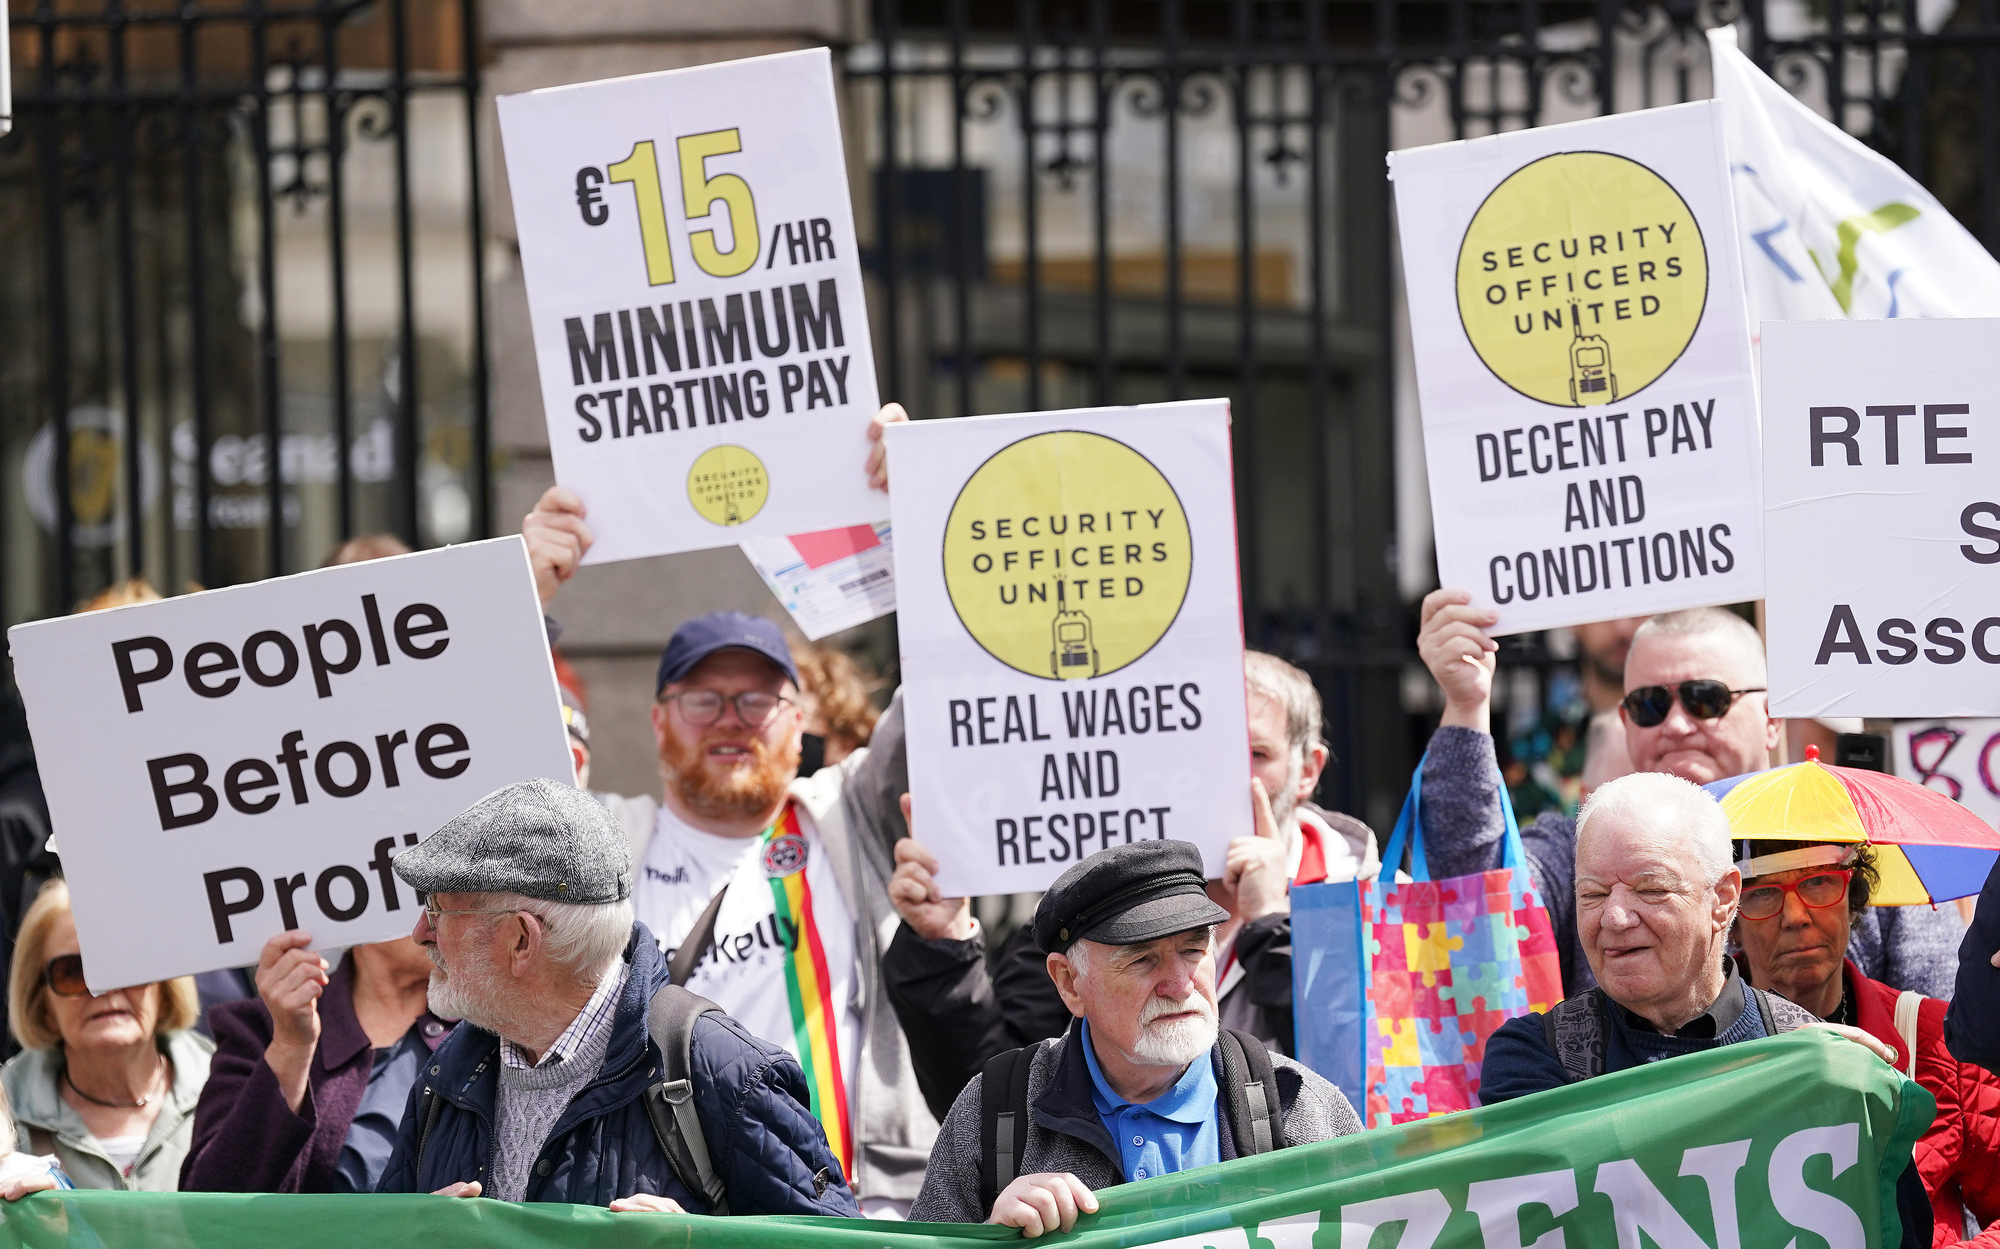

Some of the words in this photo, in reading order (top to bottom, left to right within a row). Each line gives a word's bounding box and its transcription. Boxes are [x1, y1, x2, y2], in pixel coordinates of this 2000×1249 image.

[1482, 222, 1676, 271] SECURITY
[1486, 257, 1682, 304] OFFICERS
[564, 278, 845, 386] MINIMUM
[1514, 295, 1661, 334] UNITED
[574, 369, 770, 443] STARTING
[778, 355, 851, 413] PAY
[1475, 413, 1629, 482] DECENT
[1643, 399, 1716, 458] PAY
[1809, 403, 1973, 467] RTE
[694, 466, 760, 485] SECURITY
[695, 477, 762, 495] OFFICERS
[970, 508, 1165, 540] SECURITY
[1564, 474, 1646, 532] AND
[972, 543, 1168, 573] OFFICERS
[1489, 523, 1735, 605] CONDITIONS
[999, 577, 1144, 605] UNITED
[111, 593, 450, 714] People
[949, 694, 1051, 747] REAL
[1062, 682, 1202, 738] WAGES
[146, 722, 471, 831] Before
[1041, 750, 1120, 801] AND
